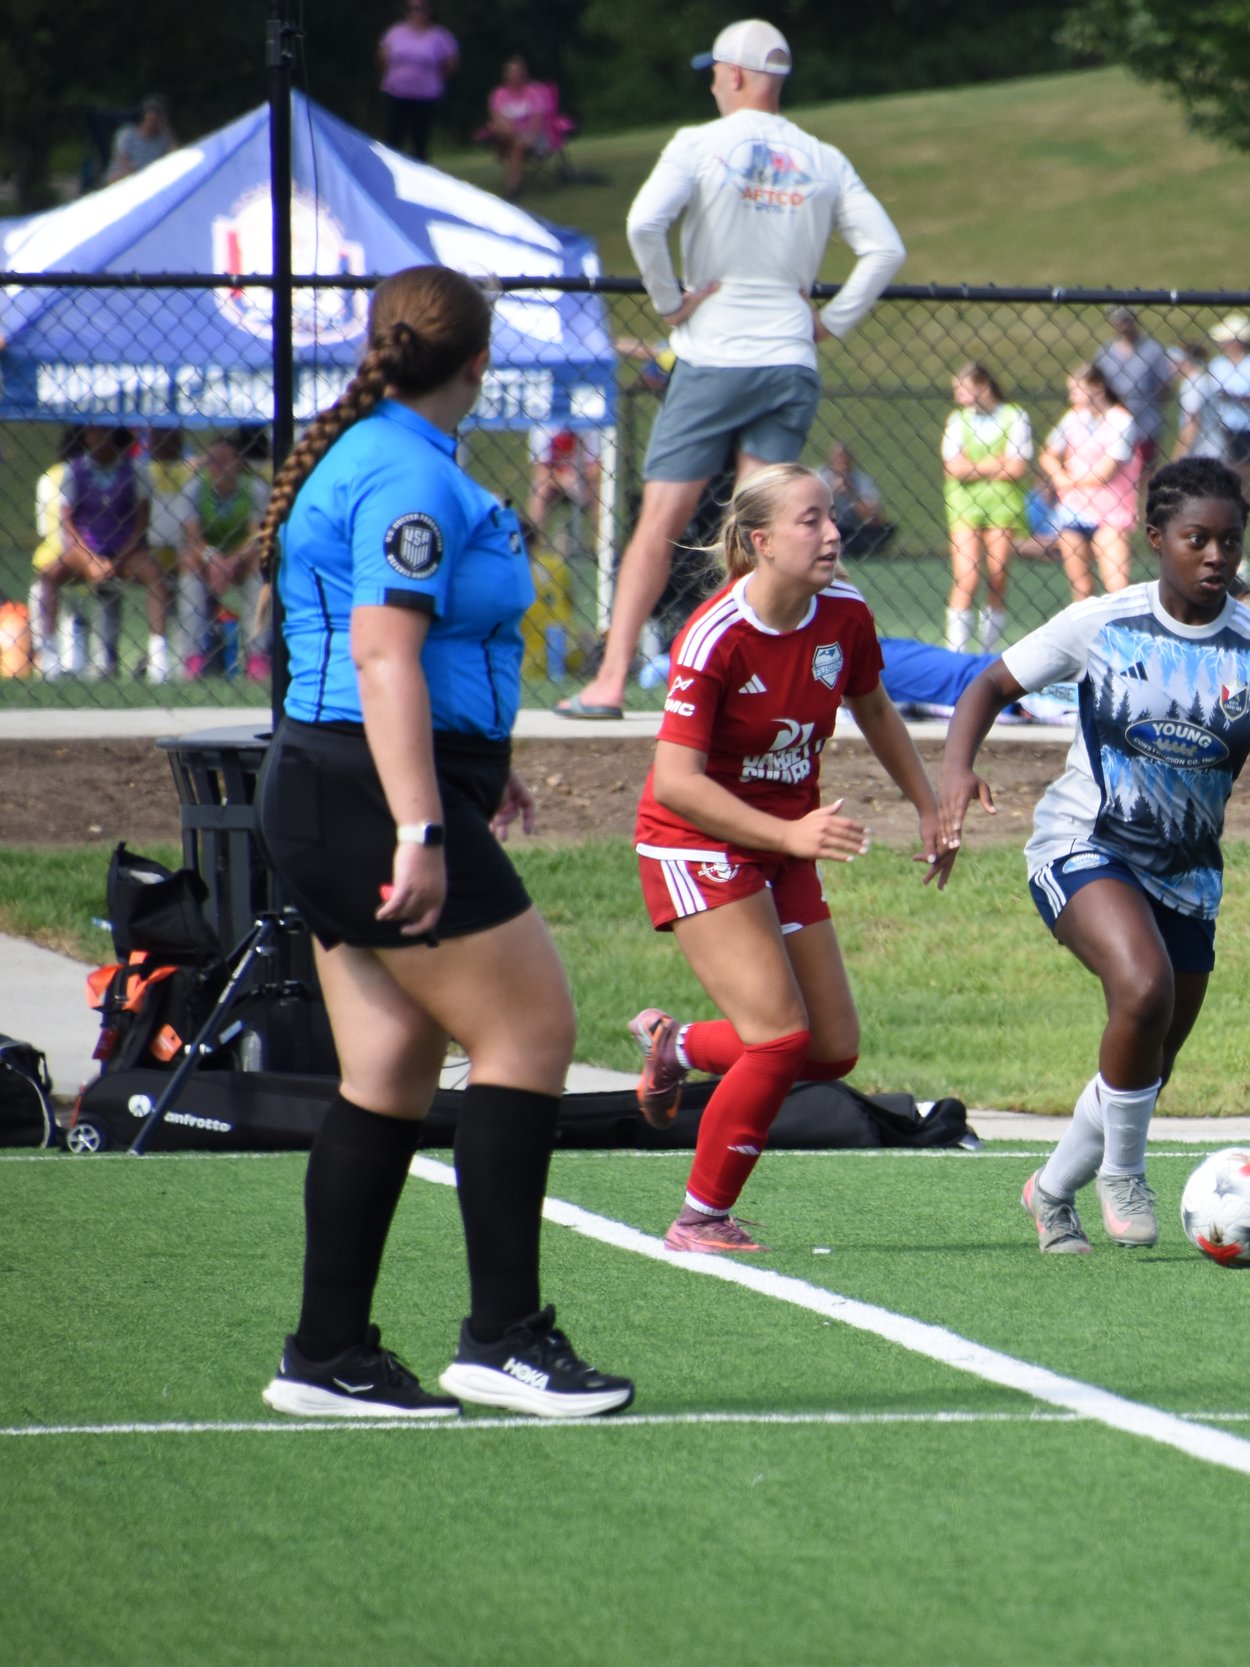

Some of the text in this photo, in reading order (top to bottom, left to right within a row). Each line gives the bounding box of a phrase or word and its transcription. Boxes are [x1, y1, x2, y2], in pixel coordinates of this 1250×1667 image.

[740, 186, 805, 206] AFTCO
[404, 528, 430, 546] USA
[1152, 723, 1212, 749] YOUNG
[152, 1105, 232, 1133] anfrotto
[503, 1357, 550, 1391] HOKA
